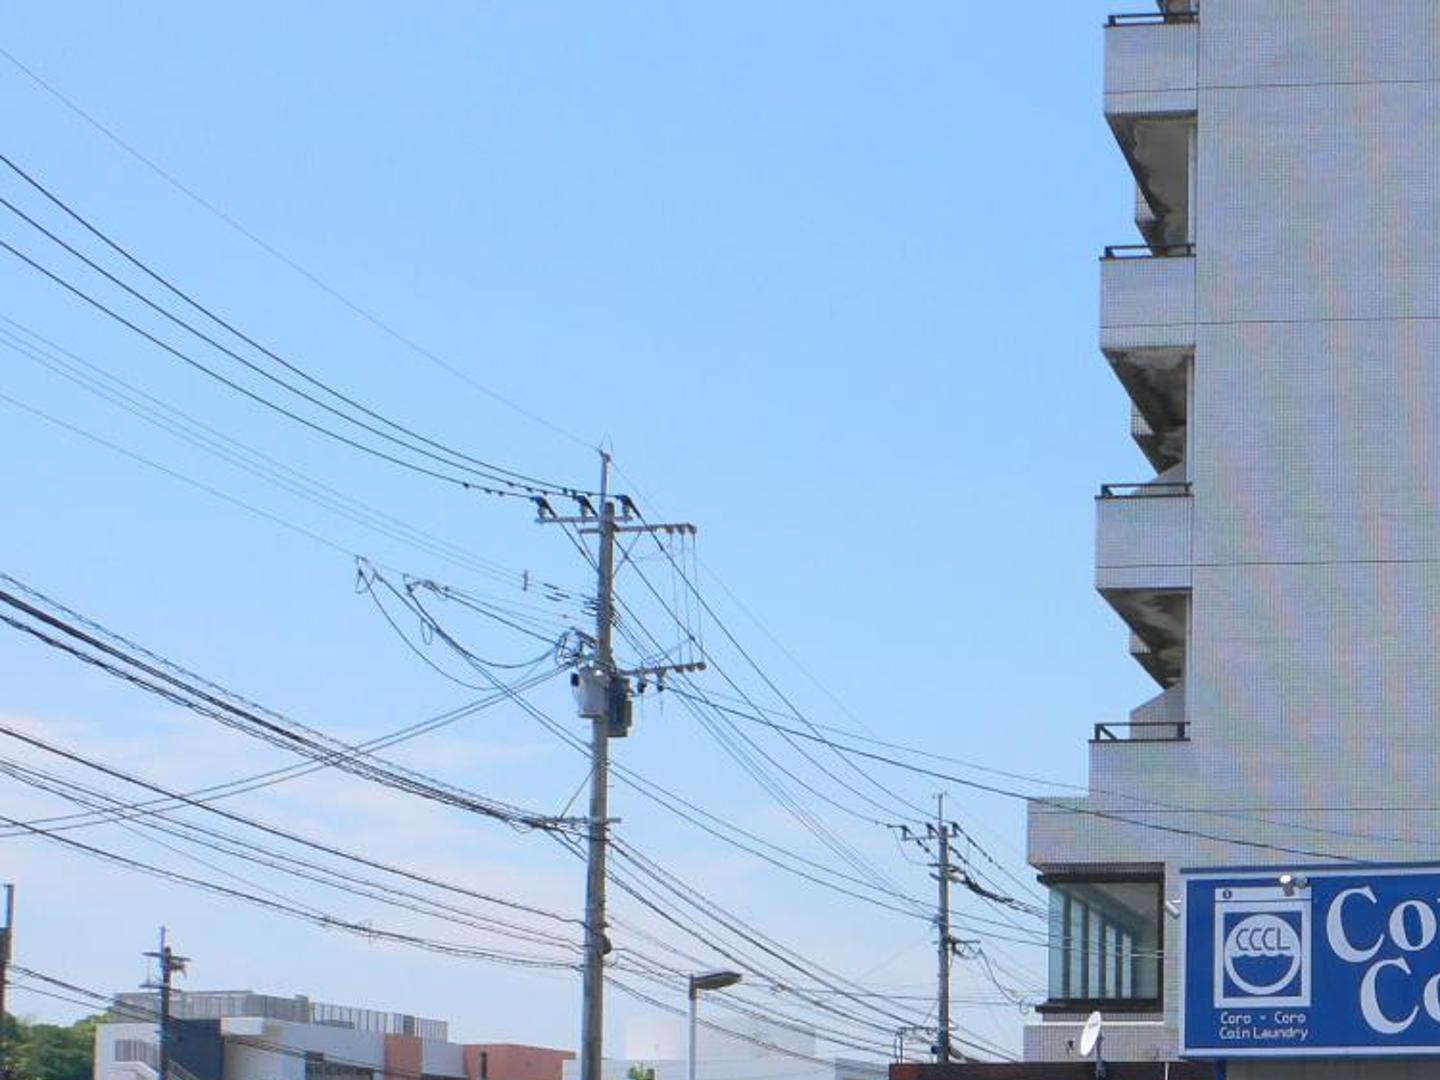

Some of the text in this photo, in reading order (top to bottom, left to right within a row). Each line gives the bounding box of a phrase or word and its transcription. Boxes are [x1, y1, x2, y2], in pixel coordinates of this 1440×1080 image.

[1236, 927, 1291, 951] CCCL
[1219, 1026, 1308, 1041] Coin Laundry
